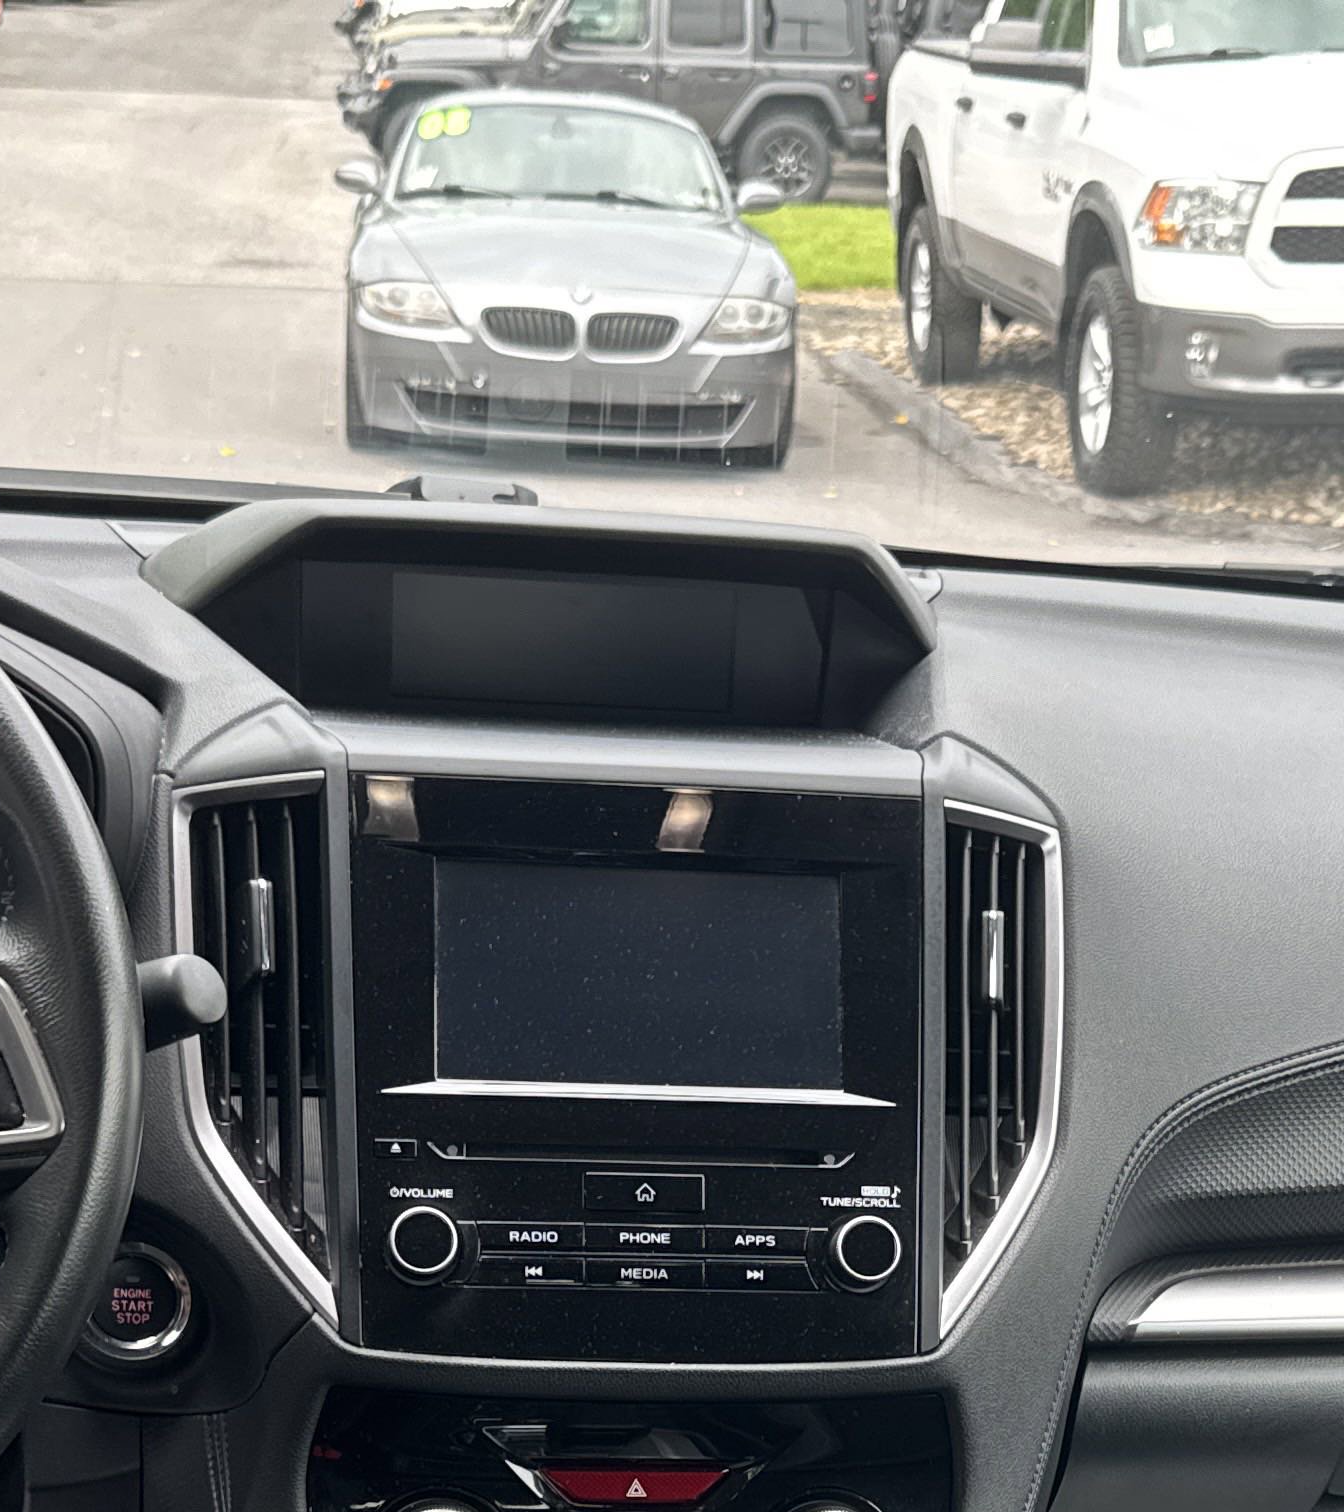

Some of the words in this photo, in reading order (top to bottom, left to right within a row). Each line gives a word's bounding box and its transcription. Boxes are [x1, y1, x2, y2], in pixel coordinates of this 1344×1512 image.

[820, 1196, 902, 1208] TUNE/SCROLL
[509, 1231, 558, 1243] RADIO
[619, 1232, 671, 1244] PHONE
[735, 1235, 776, 1247] APPS
[620, 1267, 668, 1280] MEDIA
[113, 1288, 152, 1299] ENGINE
[112, 1300, 154, 1312] START
[116, 1312, 150, 1324] STOP
